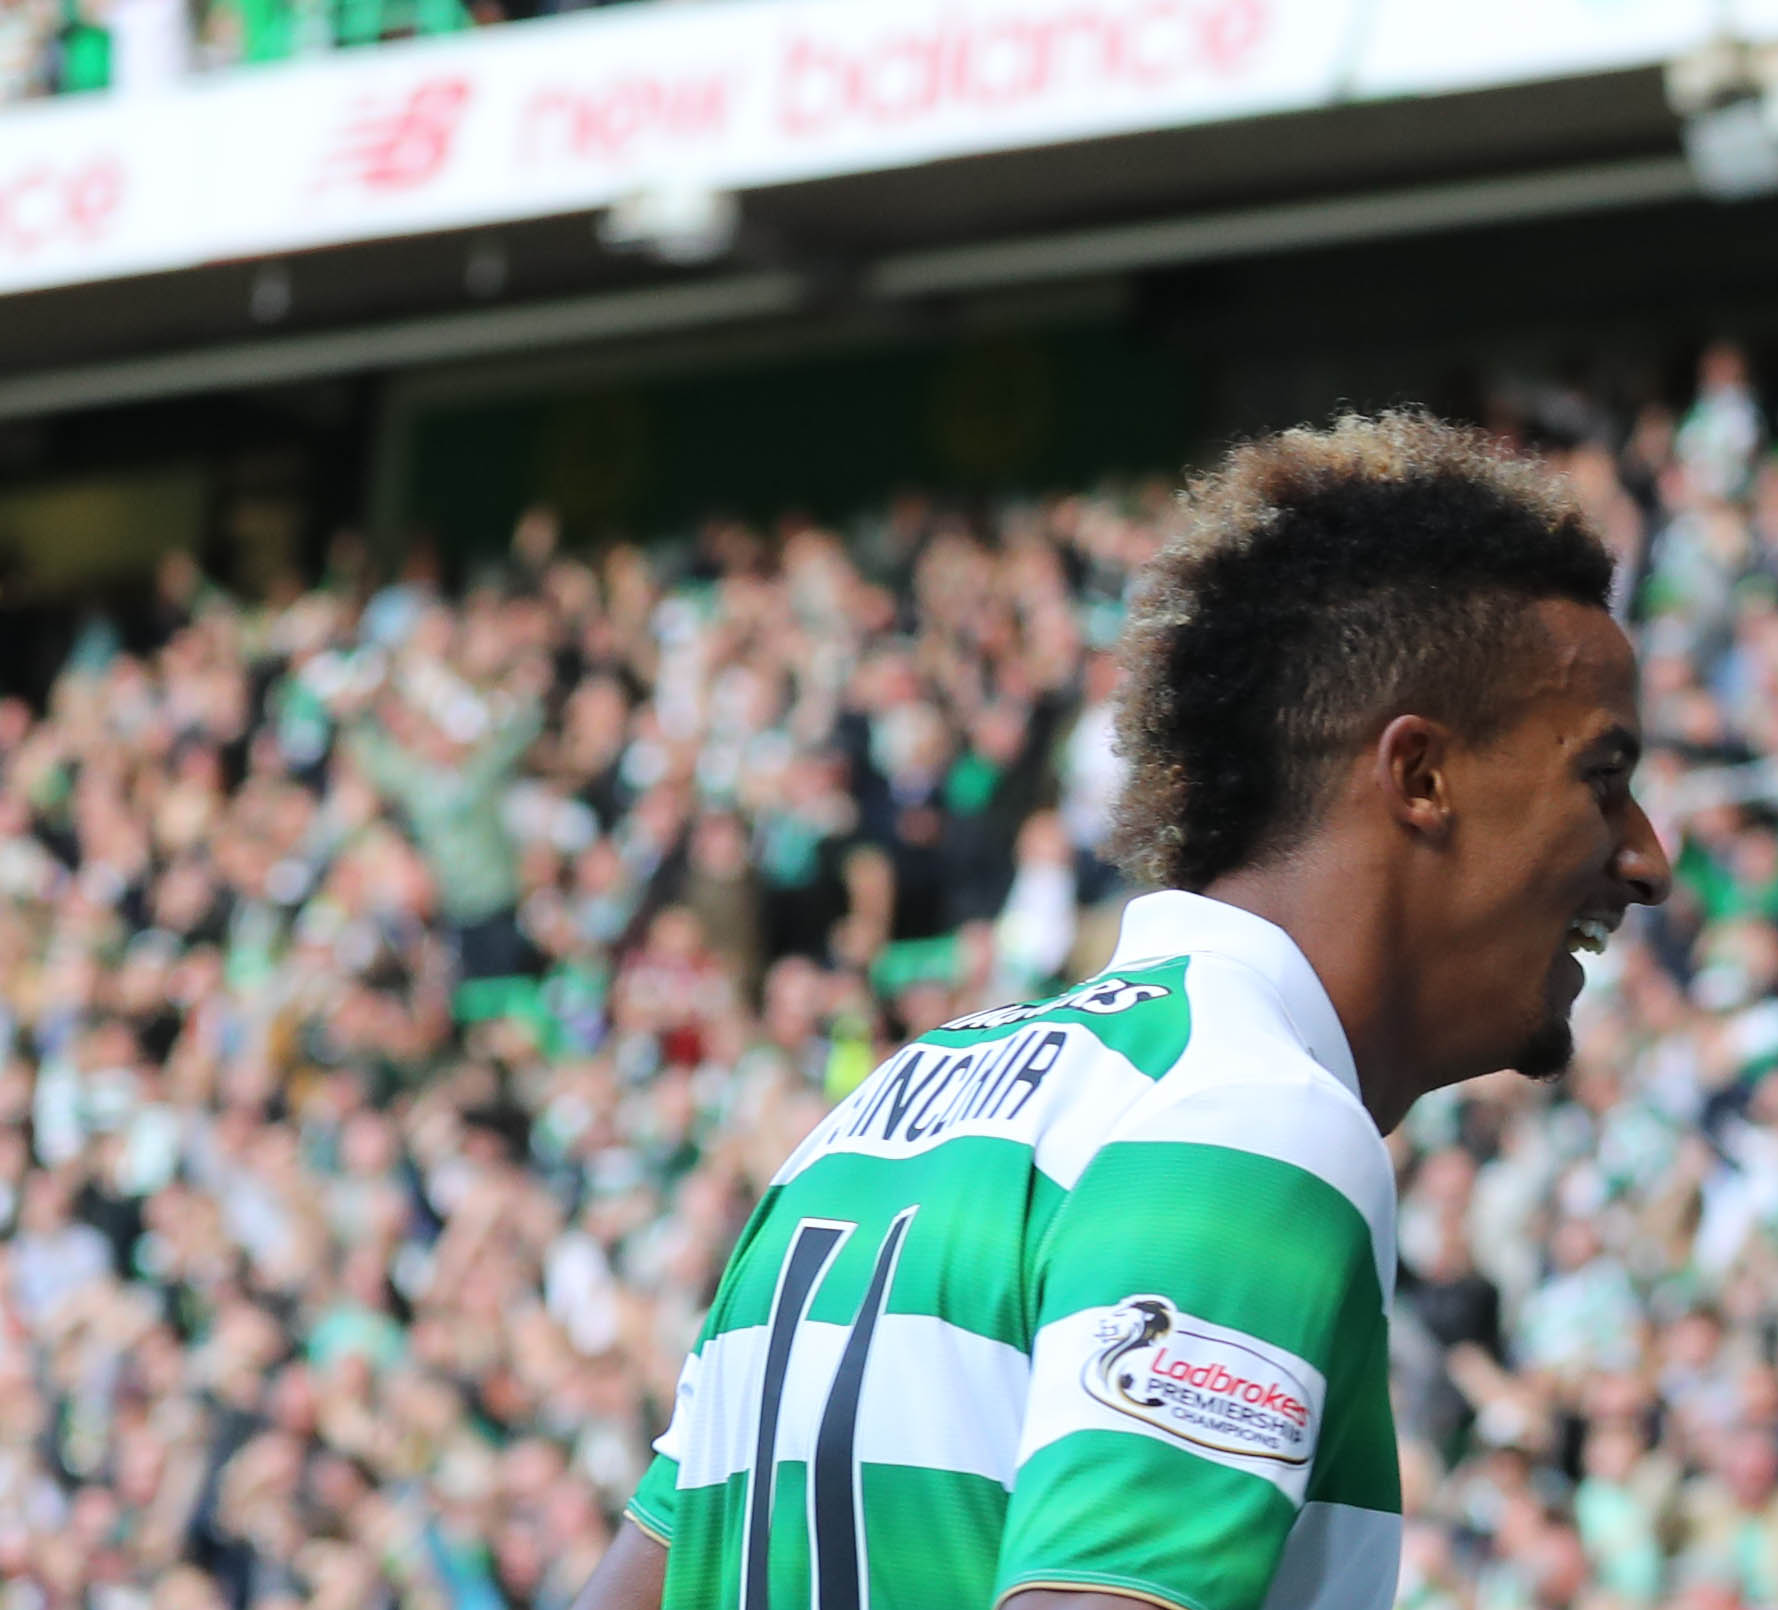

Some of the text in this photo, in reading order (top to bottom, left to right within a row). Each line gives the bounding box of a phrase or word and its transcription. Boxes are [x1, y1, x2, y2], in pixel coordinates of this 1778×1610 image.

[520, 64, 738, 164] new
[782, 0, 1266, 138] balance
[1147, 1378, 1303, 1444] PREMIERSHIP
[1151, 1348, 1309, 1427] Ladbrokes
[1171, 1407, 1281, 1450] CHAMPIONS
